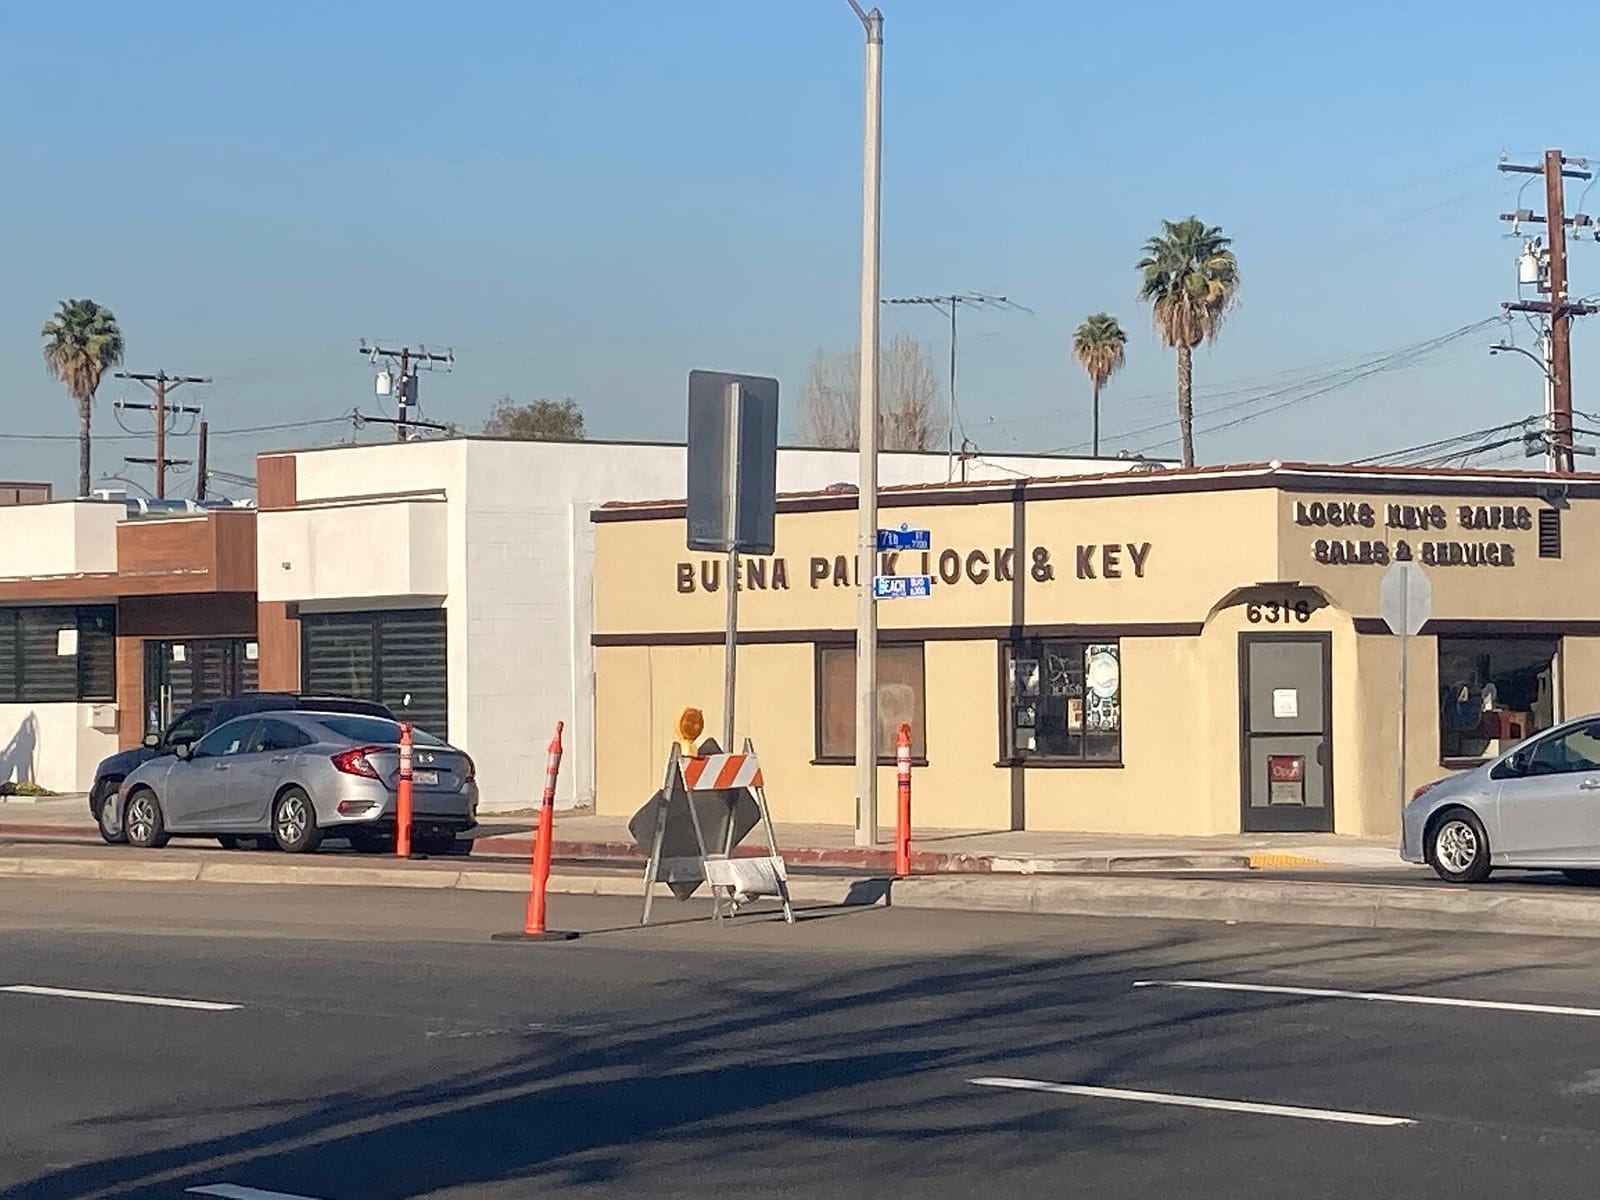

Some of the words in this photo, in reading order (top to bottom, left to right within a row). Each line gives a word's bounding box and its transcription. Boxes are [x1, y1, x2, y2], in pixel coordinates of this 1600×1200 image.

[1293, 501, 1375, 528] LOCKS
[1384, 504, 1447, 531] KEYS
[1457, 505, 1532, 530] SAFES
[880, 531, 899, 546] 7th
[1311, 539, 1390, 566] SALES
[1393, 540, 1413, 561] &
[1418, 542, 1515, 566] SERVICE
[810, 552, 899, 589] PAK
[921, 548, 1014, 585] LOCK
[1031, 546, 1055, 582] &
[1076, 542, 1152, 579] KEY
[879, 577, 906, 595] BEACH
[1247, 600, 1310, 624] 6318
